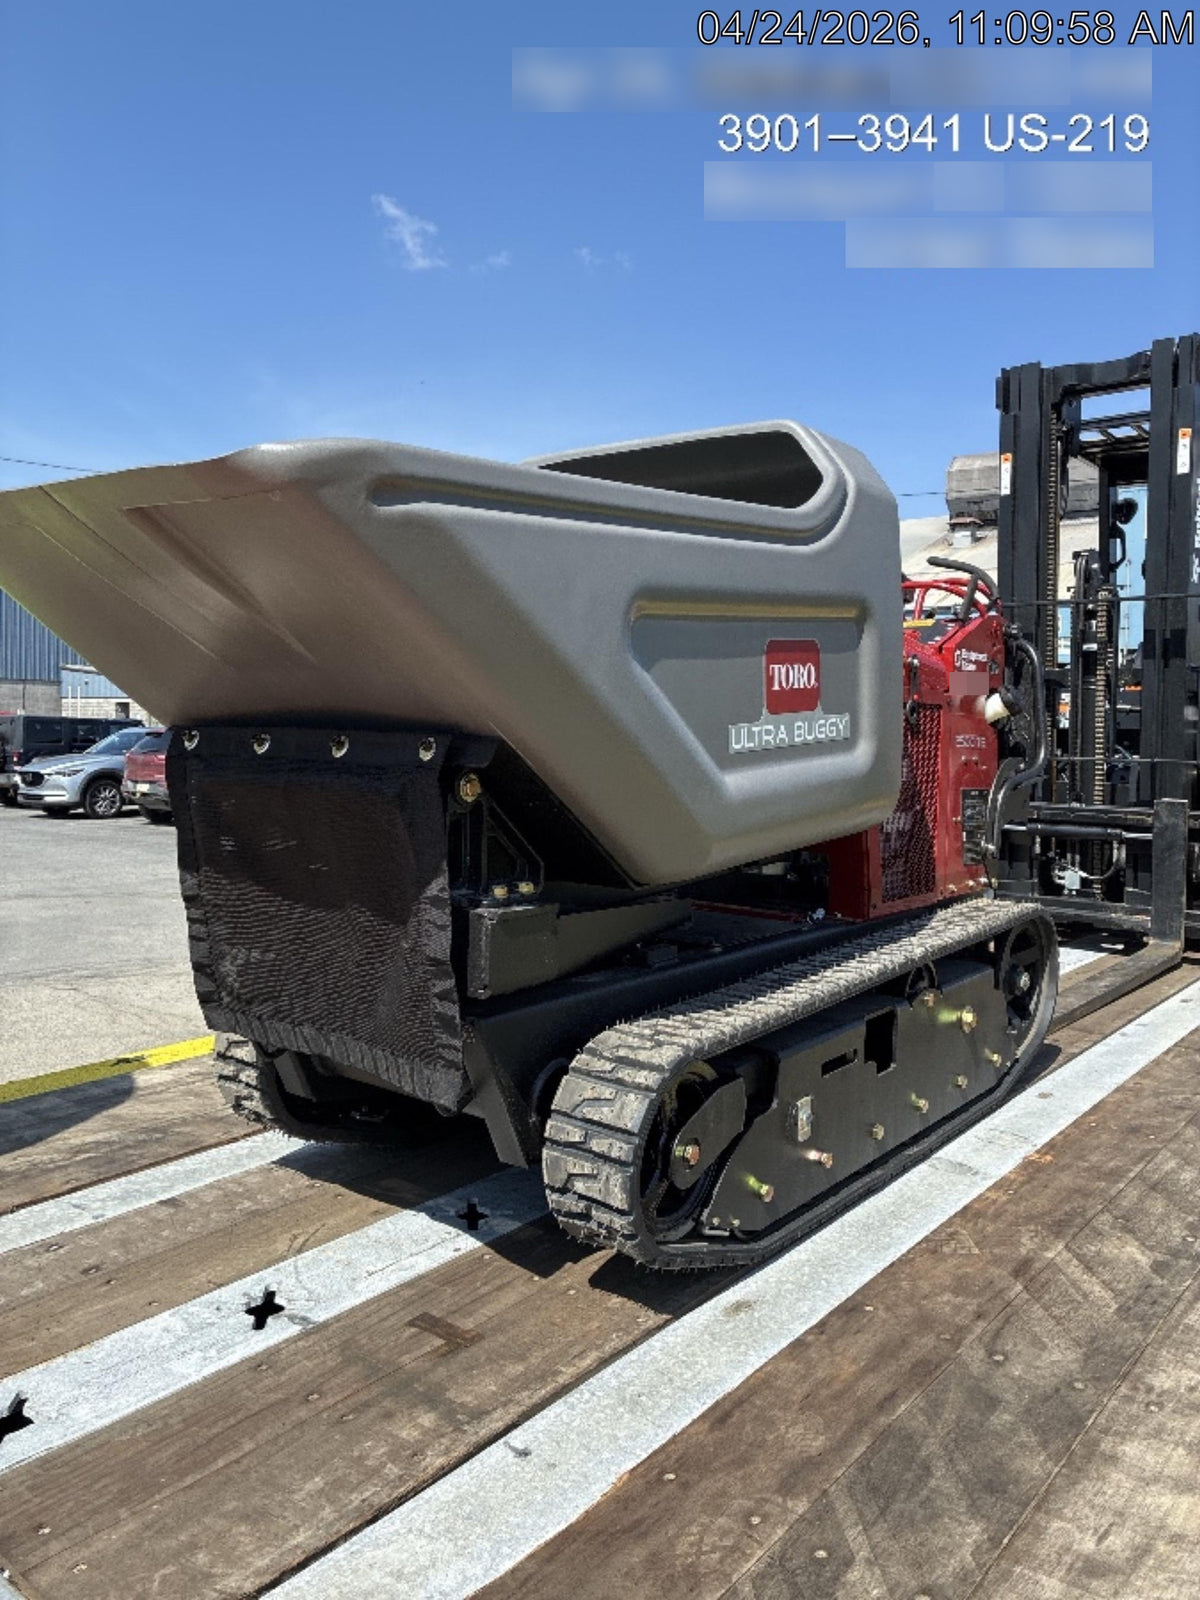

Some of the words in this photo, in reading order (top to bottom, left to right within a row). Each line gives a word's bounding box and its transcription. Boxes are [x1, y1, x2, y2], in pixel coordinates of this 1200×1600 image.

[769, 662, 816, 691] TORO
[731, 724, 789, 749] ULTRA
[794, 717, 850, 742] BUGGY
